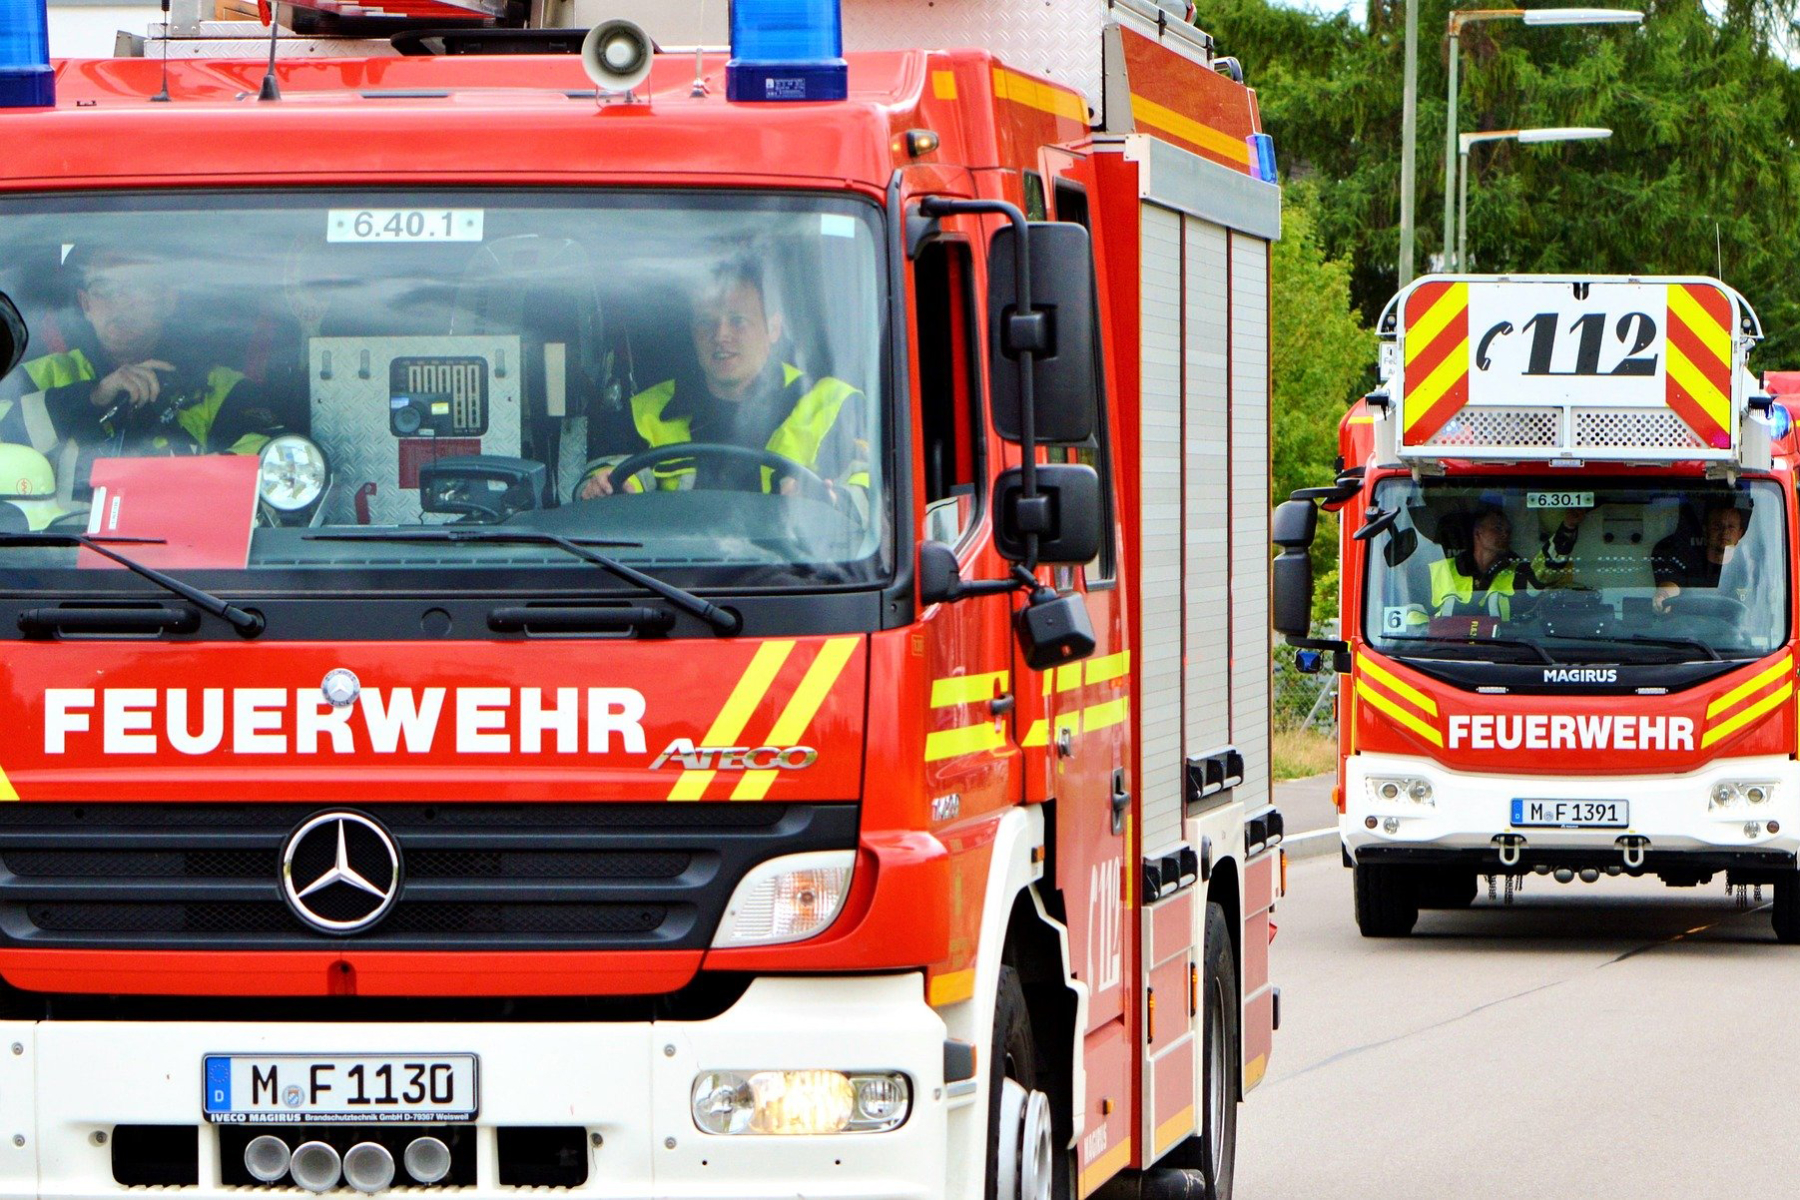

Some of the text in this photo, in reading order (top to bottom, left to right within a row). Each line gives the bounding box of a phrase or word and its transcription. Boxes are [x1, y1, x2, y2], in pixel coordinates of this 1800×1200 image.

[353, 211, 453, 238] 6.40.1
[1521, 312, 1659, 377] 112
[1538, 493, 1582, 506] 6.30.1
[1387, 610, 1402, 629] 6
[1543, 669, 1618, 683] MAGIRUS
[44, 686, 648, 755] FEUERWEHR
[1448, 714, 1695, 751] FEUERWEHR
[648, 738, 819, 770] ATEGO
[1531, 802, 1543, 821] M
[1098, 855, 1121, 993] 112
[214, 1090, 225, 1103] D
[252, 1064, 278, 1105] M
[210, 1113, 246, 1122] IVECO
[249, 1113, 302, 1122] MAGIRUS
[304, 1113, 378, 1121] Brandschutztechnik
[379, 1113, 403, 1121] GmbH
